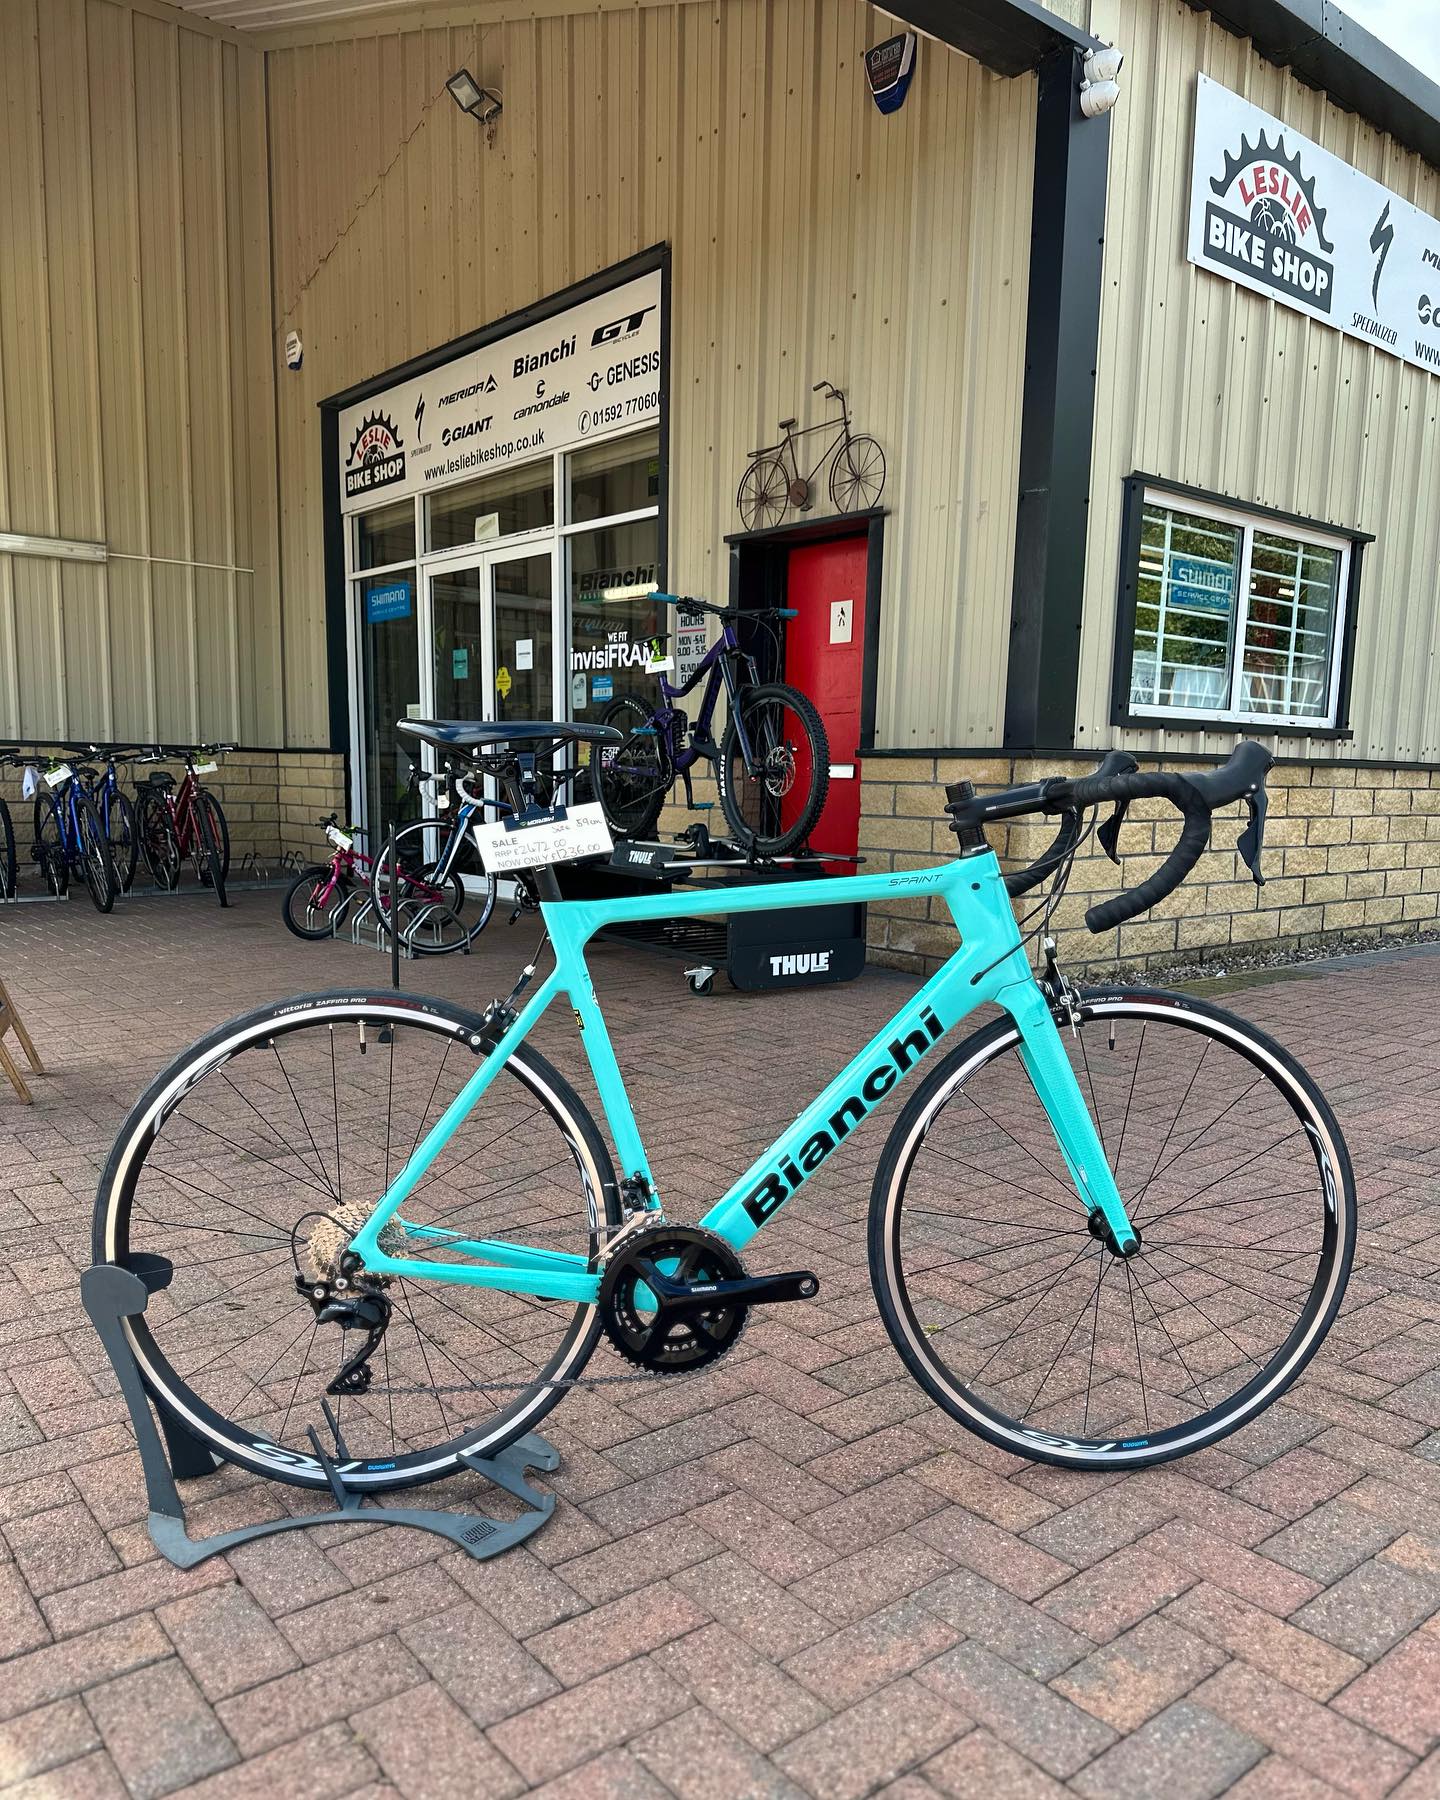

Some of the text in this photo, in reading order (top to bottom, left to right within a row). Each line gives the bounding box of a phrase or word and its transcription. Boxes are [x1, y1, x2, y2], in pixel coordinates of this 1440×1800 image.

[1238, 165, 1312, 237] LESLIE
[1208, 213, 1329, 297] BIKE SHOP
[591, 304, 657, 347] GT
[1350, 312, 1398, 346] SPECIALIZED
[513, 335, 577, 379] Bianchi
[607, 350, 660, 386] GENESIS
[438, 381, 485, 408] MERIDA
[513, 390, 570, 421] cannondale
[593, 403, 622, 426] 01592
[452, 415, 493, 442] GIANT
[356, 425, 391, 460] LESLIE
[424, 428, 545, 481] www.lesliebikeshop.co.uk
[346, 457, 404, 492] BIKE SHOP
[580, 564, 655, 591] Bianchi
[371, 589, 406, 607] SHIMANO
[607, 631, 628, 642] WE FIT
[678, 636, 692, 646] MON
[491, 837, 518, 848] SALE
[494, 849, 512, 859] RRP
[497, 858, 521, 869] NOW
[523, 855, 549, 867] ONLY
[628, 850, 653, 864] THULE
[888, 874, 943, 888] SPRINT
[769, 951, 830, 976] THULE
[741, 1005, 945, 1229] Bianchi
[690, 1284, 718, 1294] SHIMANO
